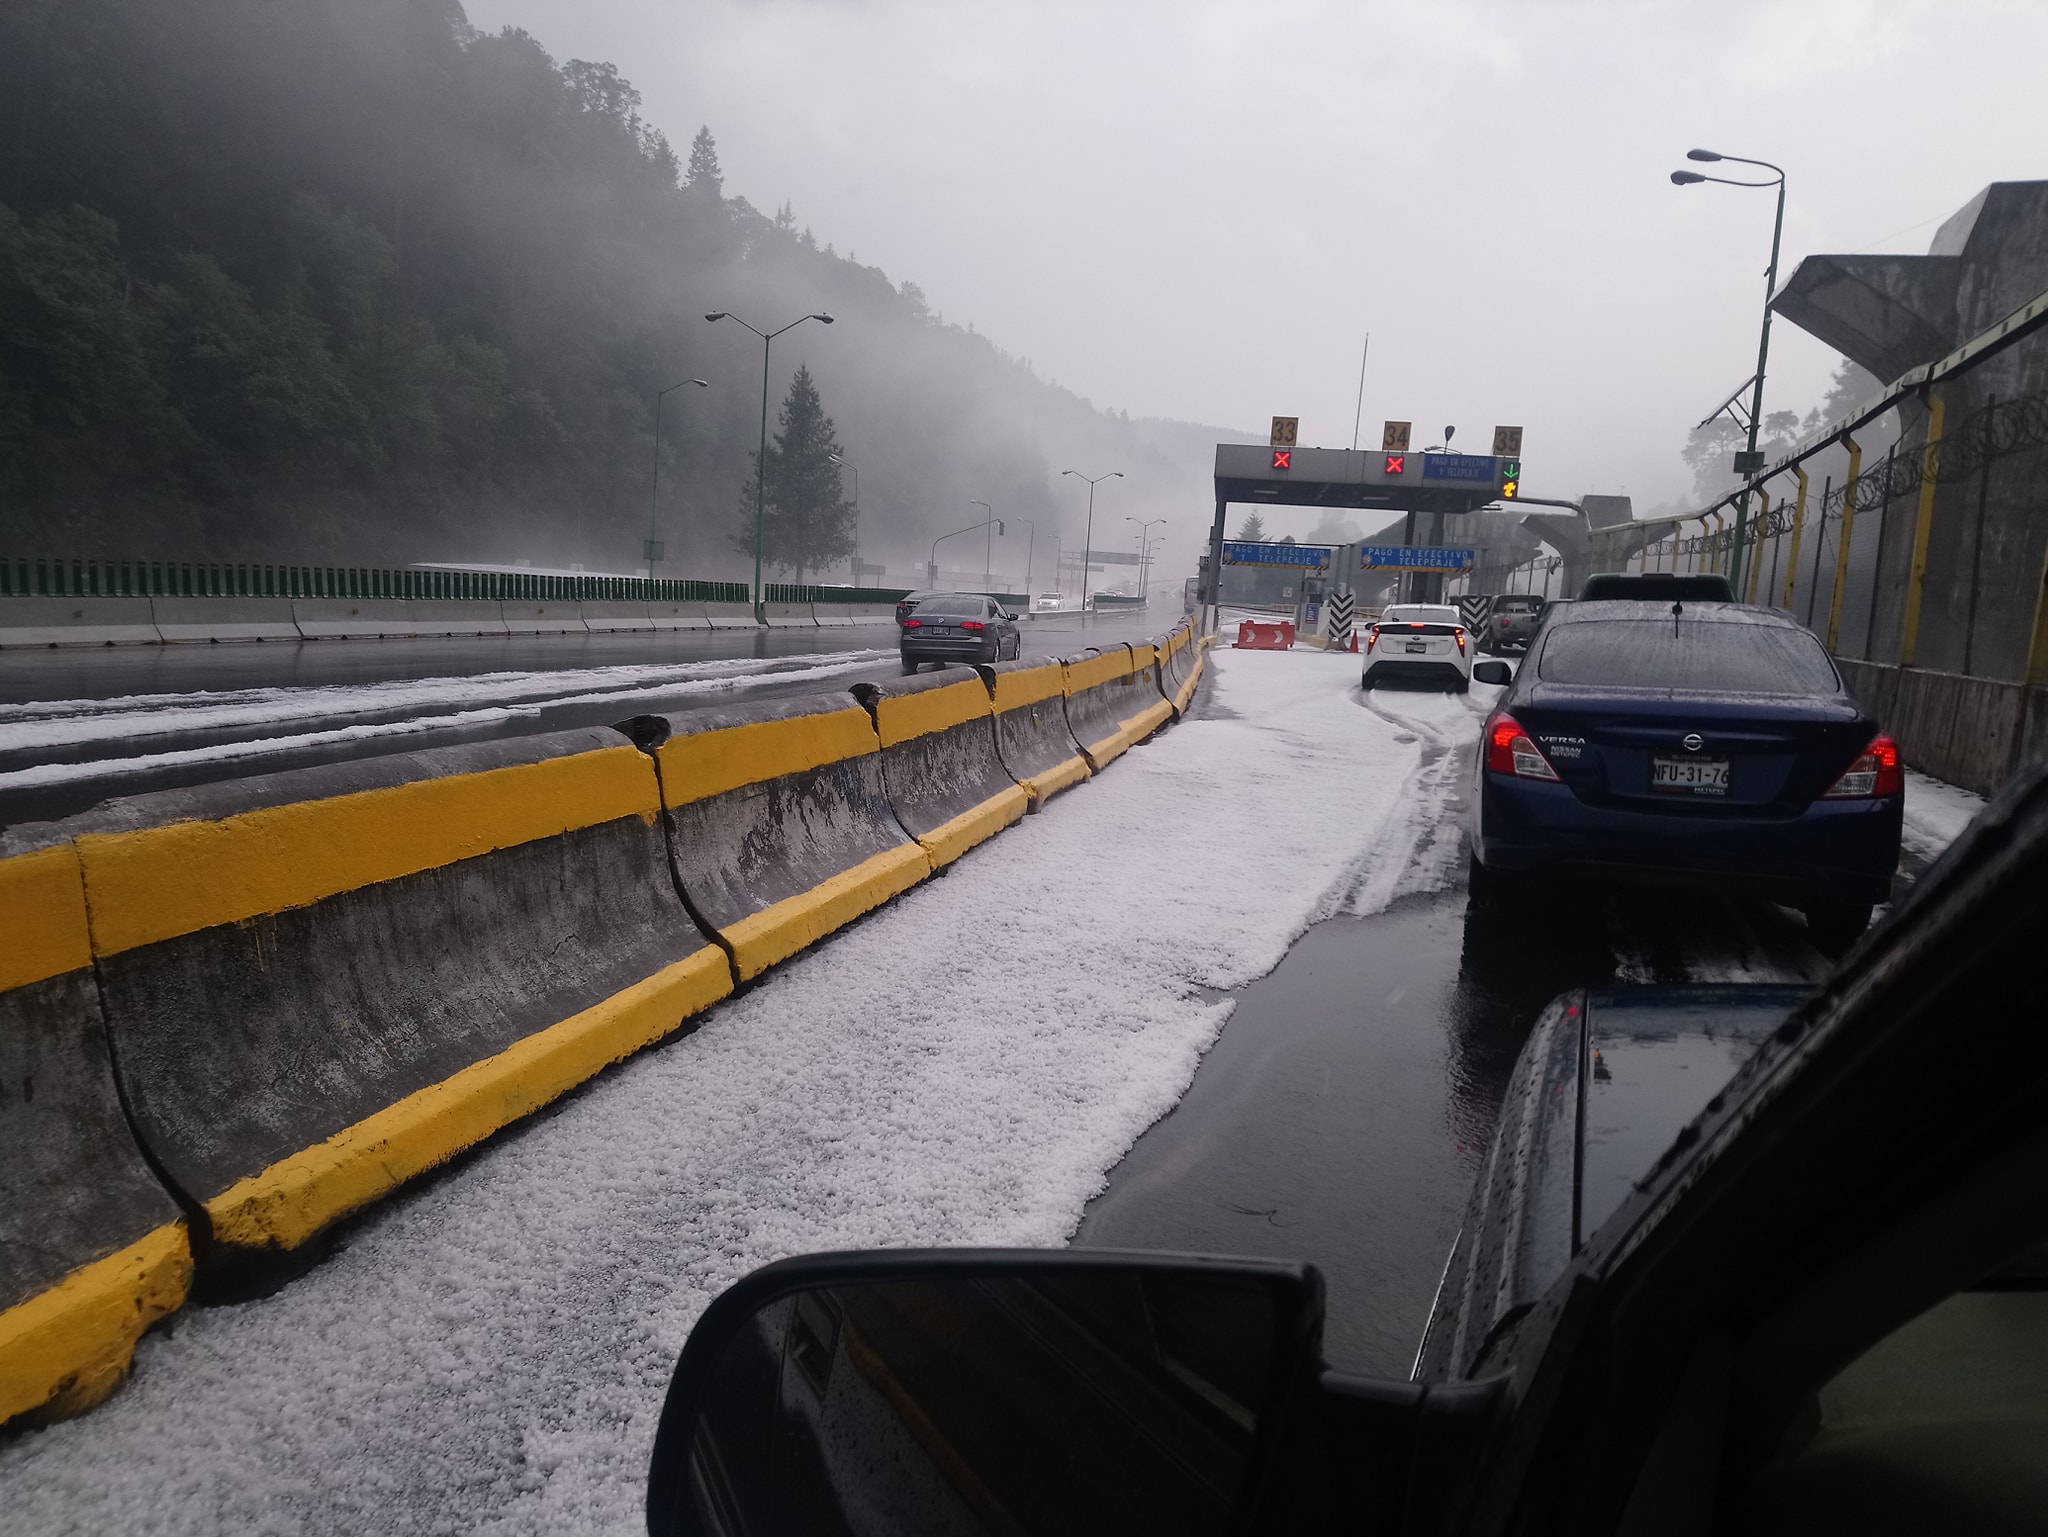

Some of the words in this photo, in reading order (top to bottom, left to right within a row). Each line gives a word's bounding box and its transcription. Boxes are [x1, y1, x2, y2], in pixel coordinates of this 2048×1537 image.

[1273, 420, 1296, 442] 33
[1384, 425, 1408, 447] 34
[1495, 430, 1520, 452] 35
[1229, 544, 1253, 554] PAGO
[1259, 546, 1270, 554] EN
[1276, 547, 1325, 557] EFECTIVO
[1368, 547, 1393, 556] PAGO
[1399, 549, 1411, 557] EN
[1418, 549, 1468, 559] EFECTIVO
[1259, 554, 1311, 565] TELEPEAJE
[1400, 557, 1454, 567] TELEPEAJE
[1539, 735, 1586, 744] VERSA
[1654, 764, 1729, 784] NFU-31-76
